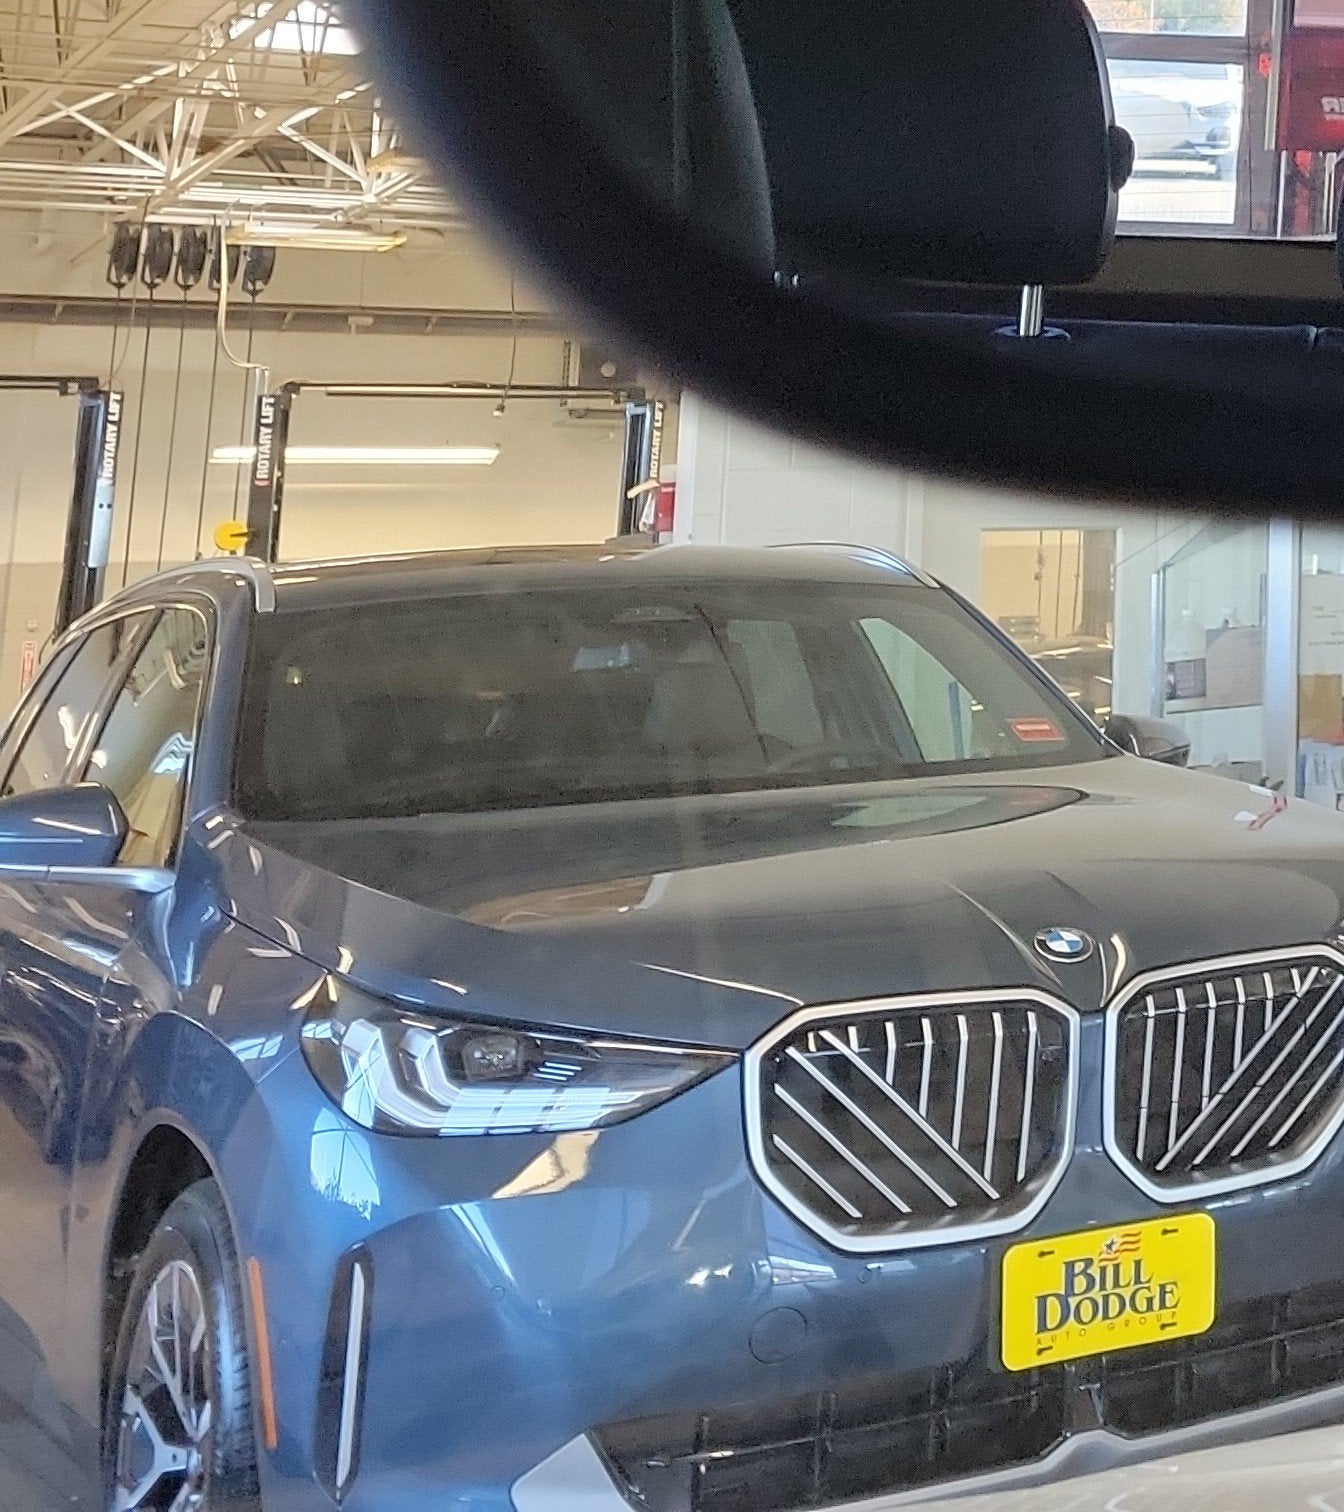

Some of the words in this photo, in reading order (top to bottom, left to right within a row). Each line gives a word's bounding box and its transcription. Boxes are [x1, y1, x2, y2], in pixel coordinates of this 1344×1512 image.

[107, 391, 122, 422] LIFT
[260, 396, 275, 424] LIFT
[102, 422, 119, 479] ROTARY
[256, 425, 273, 479] ROTARY
[1063, 1258, 1153, 1297] BILL
[1035, 1281, 1180, 1334] DODGE
[1036, 1329, 1087, 1346] AUTO
[1107, 1312, 1178, 1331] GROUP
